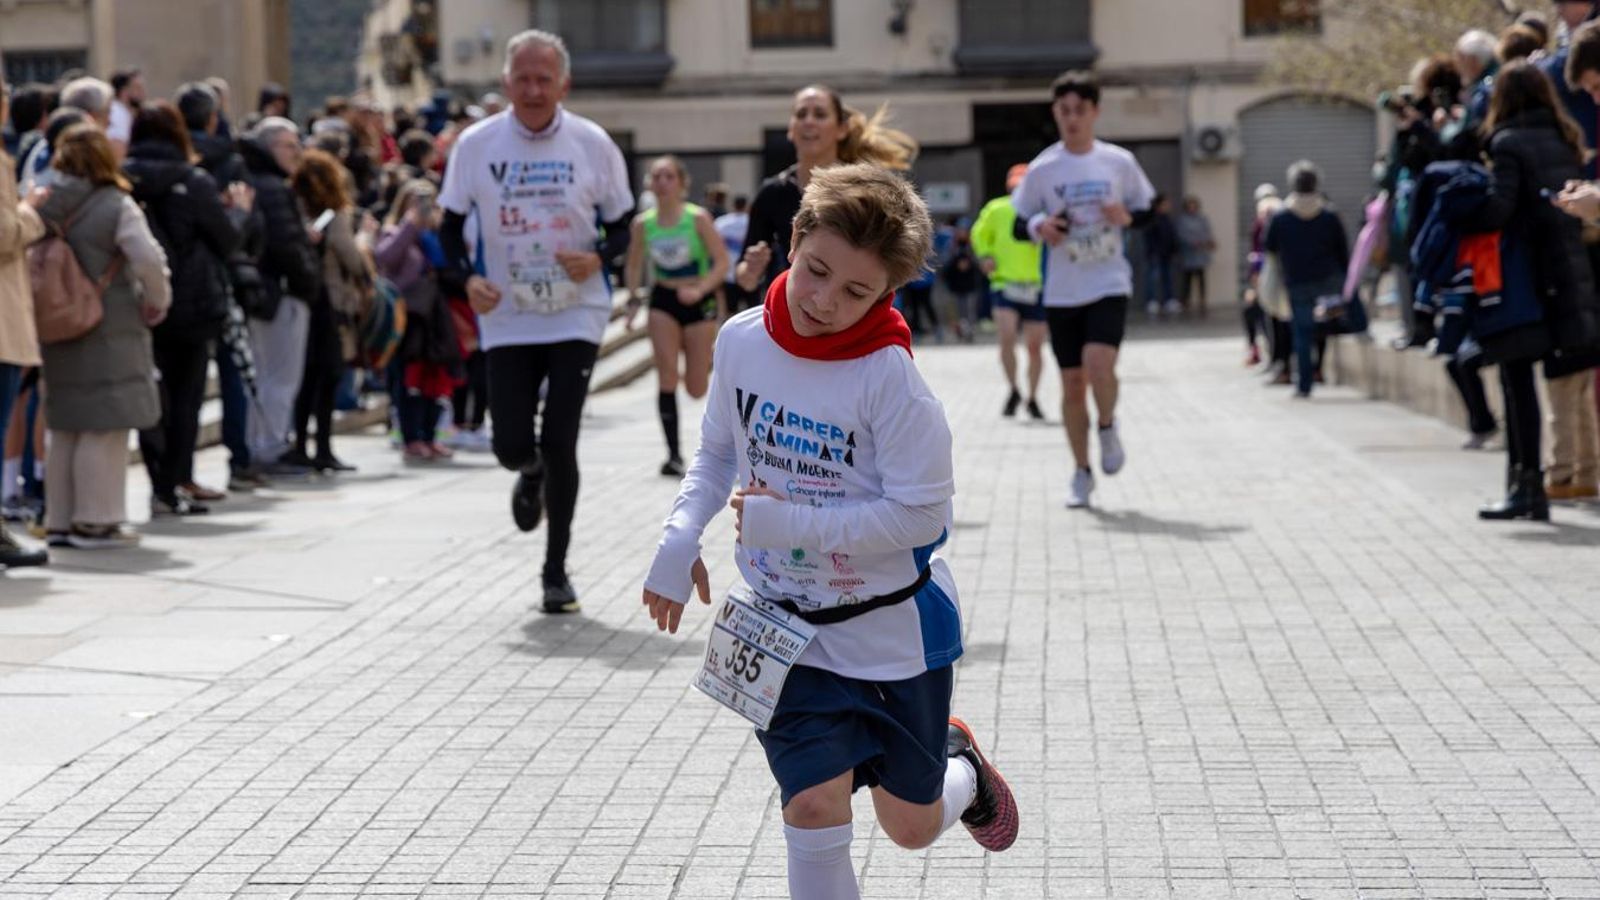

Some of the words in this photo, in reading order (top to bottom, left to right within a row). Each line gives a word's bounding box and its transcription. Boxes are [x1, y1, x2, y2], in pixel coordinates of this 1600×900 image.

[490, 161, 507, 183] V
[531, 281, 552, 298] 91
[735, 387, 759, 437] V
[760, 401, 857, 448] CARRERA
[754, 422, 855, 468] CAMINATA
[764, 451, 793, 474] BUENA
[796, 460, 842, 479] MUERTE
[722, 601, 736, 621] V
[778, 634, 800, 653] BUENA
[724, 638, 765, 684] 355
